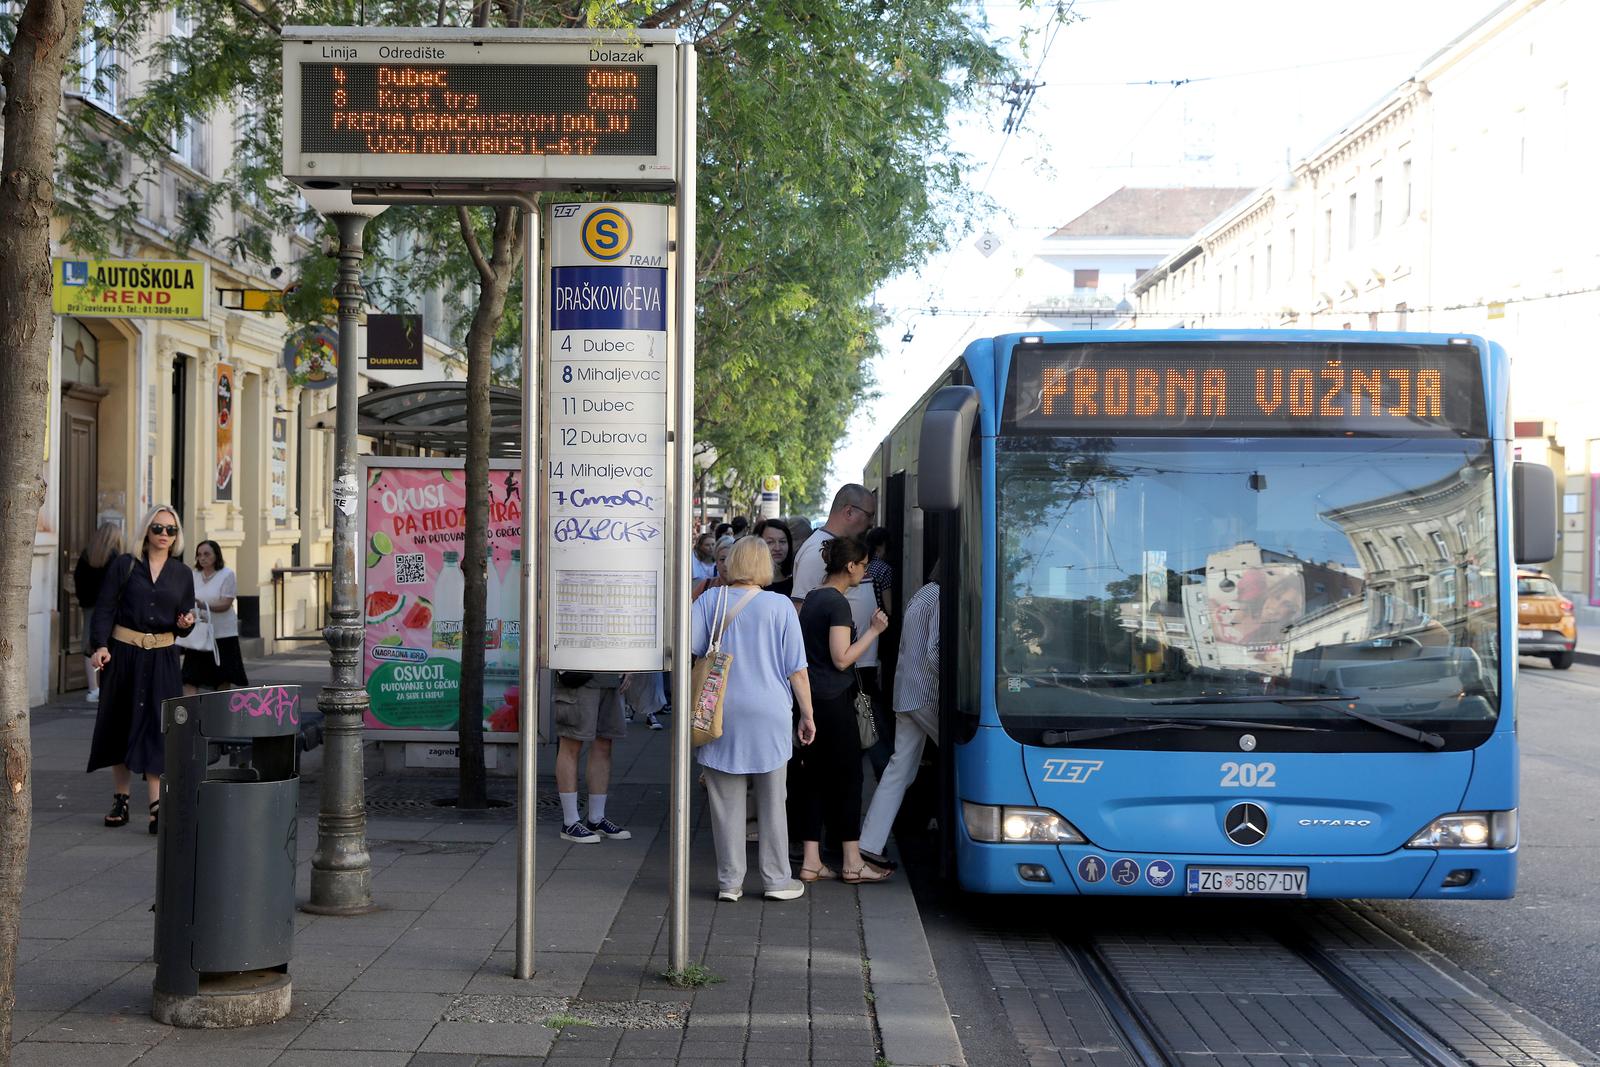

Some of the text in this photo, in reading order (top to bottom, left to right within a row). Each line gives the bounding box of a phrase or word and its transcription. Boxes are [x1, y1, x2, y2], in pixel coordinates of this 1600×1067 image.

[322, 45, 644, 63] Linija Odredište Dolazak
[334, 67, 637, 88] 4 Dubec 0min
[334, 89, 346, 107] 8
[444, 91, 478, 109] trg
[588, 92, 637, 110] 0min
[334, 112, 405, 130] PREMA
[367, 135, 416, 153] VOZI
[424, 136, 524, 154] AUTOBUS
[554, 205, 581, 218] ZET
[595, 219, 619, 249] S
[629, 254, 662, 267] TRAM
[97, 263, 195, 289] AUTOŠKOLA
[90, 290, 171, 304] REND
[556, 282, 661, 311] DRAŠKOVIĆEVA
[561, 335, 636, 353] 4 Dubec
[370, 357, 418, 365] DUBRAVICA
[562, 365, 661, 383] 8 Mihaljevac
[1043, 360, 1441, 417] PROBNA VOŽNJA
[562, 397, 635, 415] 11 Dubec
[561, 428, 648, 446] 12 Dubrava
[549, 461, 654, 480] 14 Mihaljevac
[381, 483, 448, 514] OKUSI
[393, 514, 417, 536] PA
[414, 535, 427, 545] NA
[374, 648, 409, 659] NAGRADNA
[393, 664, 445, 681] OSVOJI
[381, 678, 459, 692] PUTOVANJE U GRČKU
[396, 692, 405, 700] ZA
[428, 748, 455, 757] zagreb
[1043, 758, 1277, 788] ZET 202
[1298, 818, 1371, 827] CITARO
[1201, 872, 1222, 890] ZG
